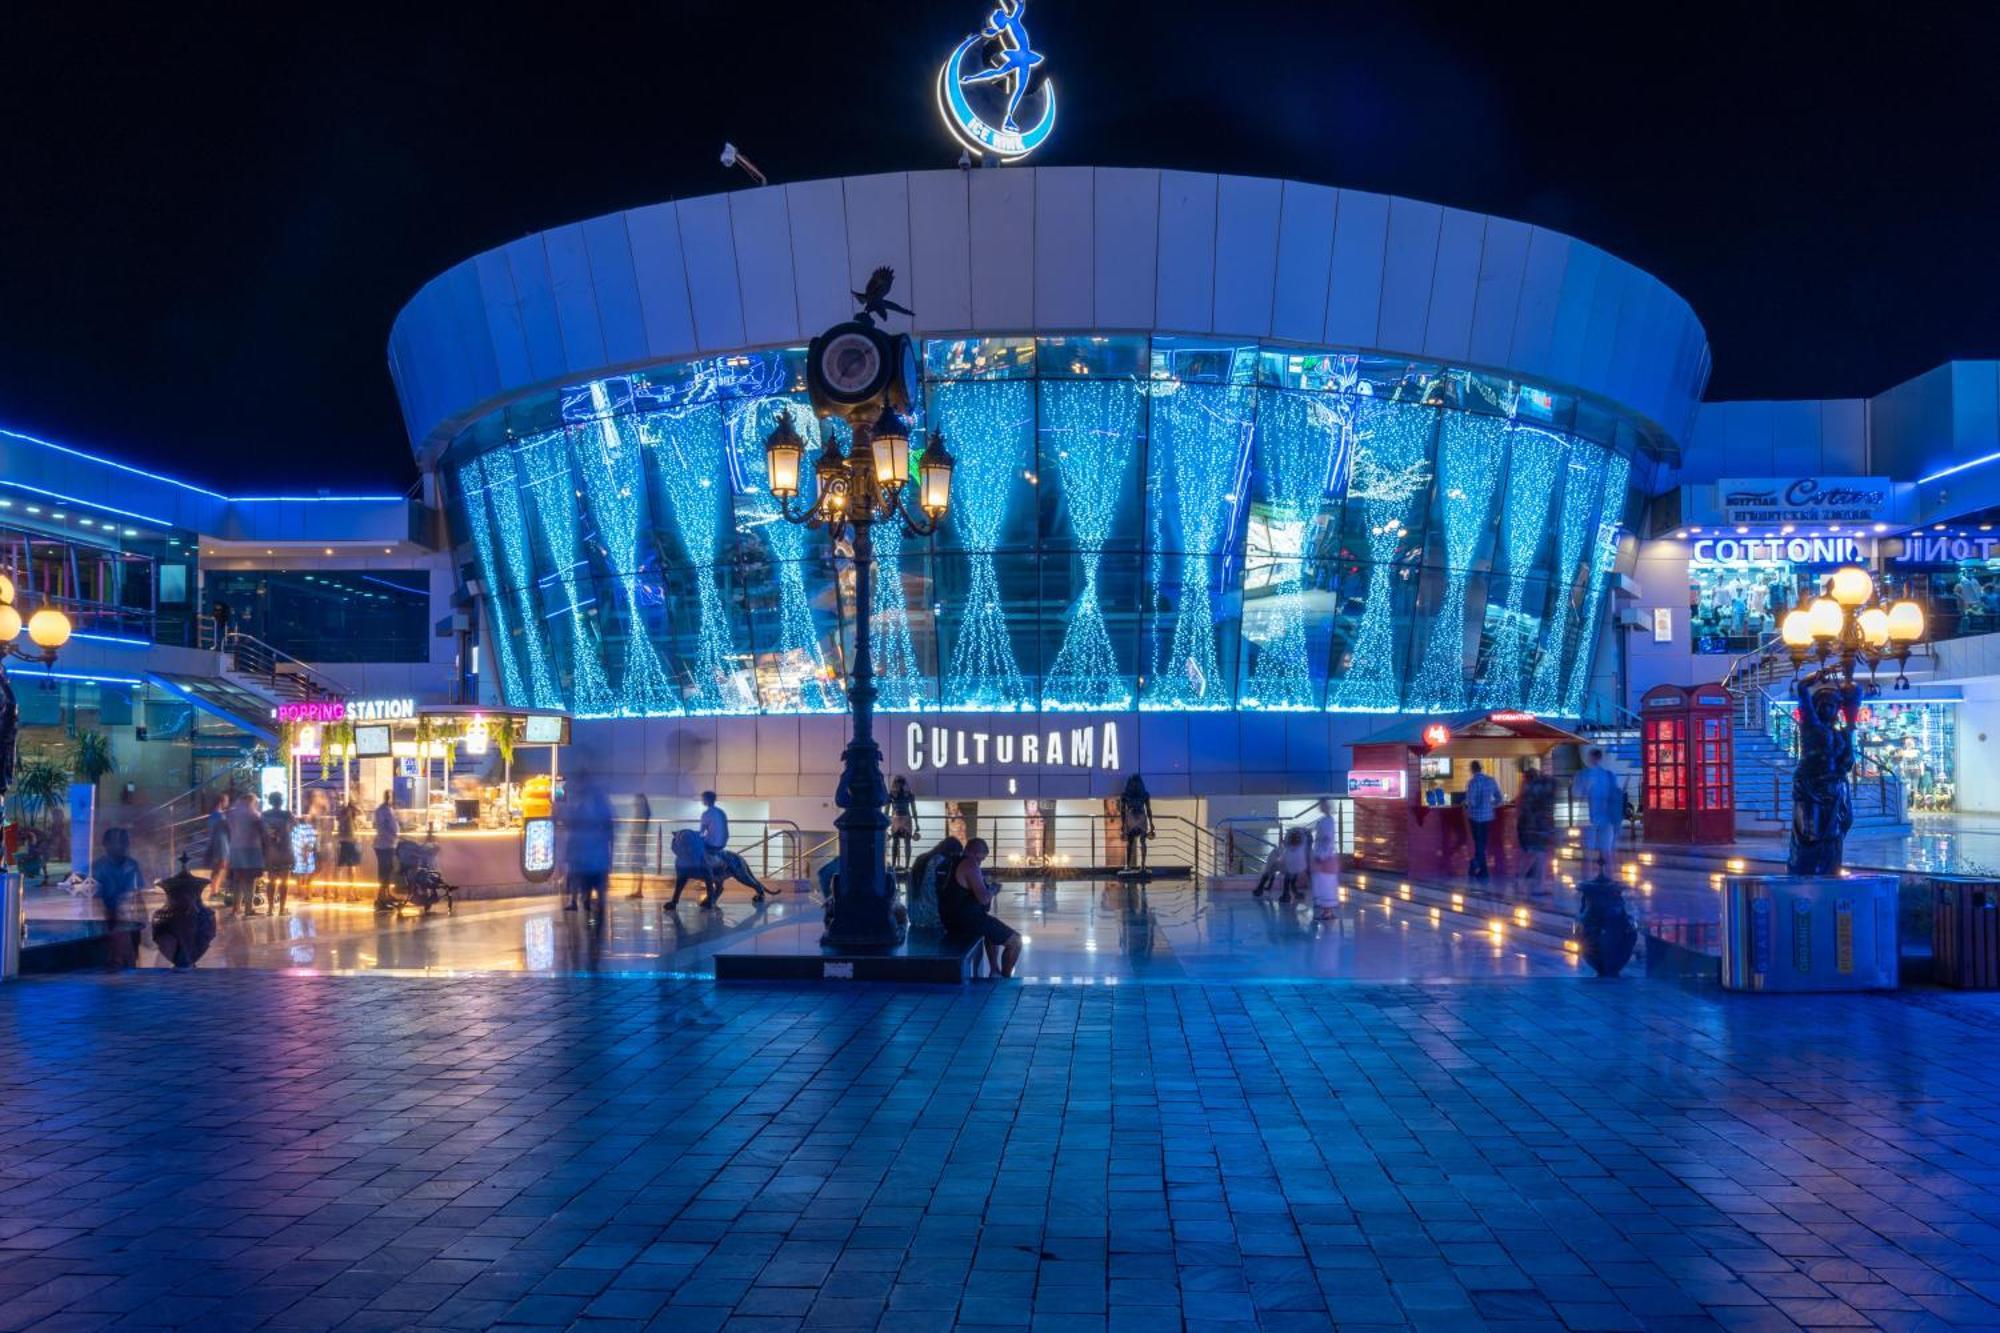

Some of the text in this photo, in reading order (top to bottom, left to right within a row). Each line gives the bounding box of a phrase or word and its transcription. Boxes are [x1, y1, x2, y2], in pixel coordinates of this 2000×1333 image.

[967, 118, 989, 142] ICE
[278, 698, 415, 722] POPPING STATION
[906, 721, 1121, 771] CULTURAMA
[1798, 916, 1810, 972] ORGANIC
